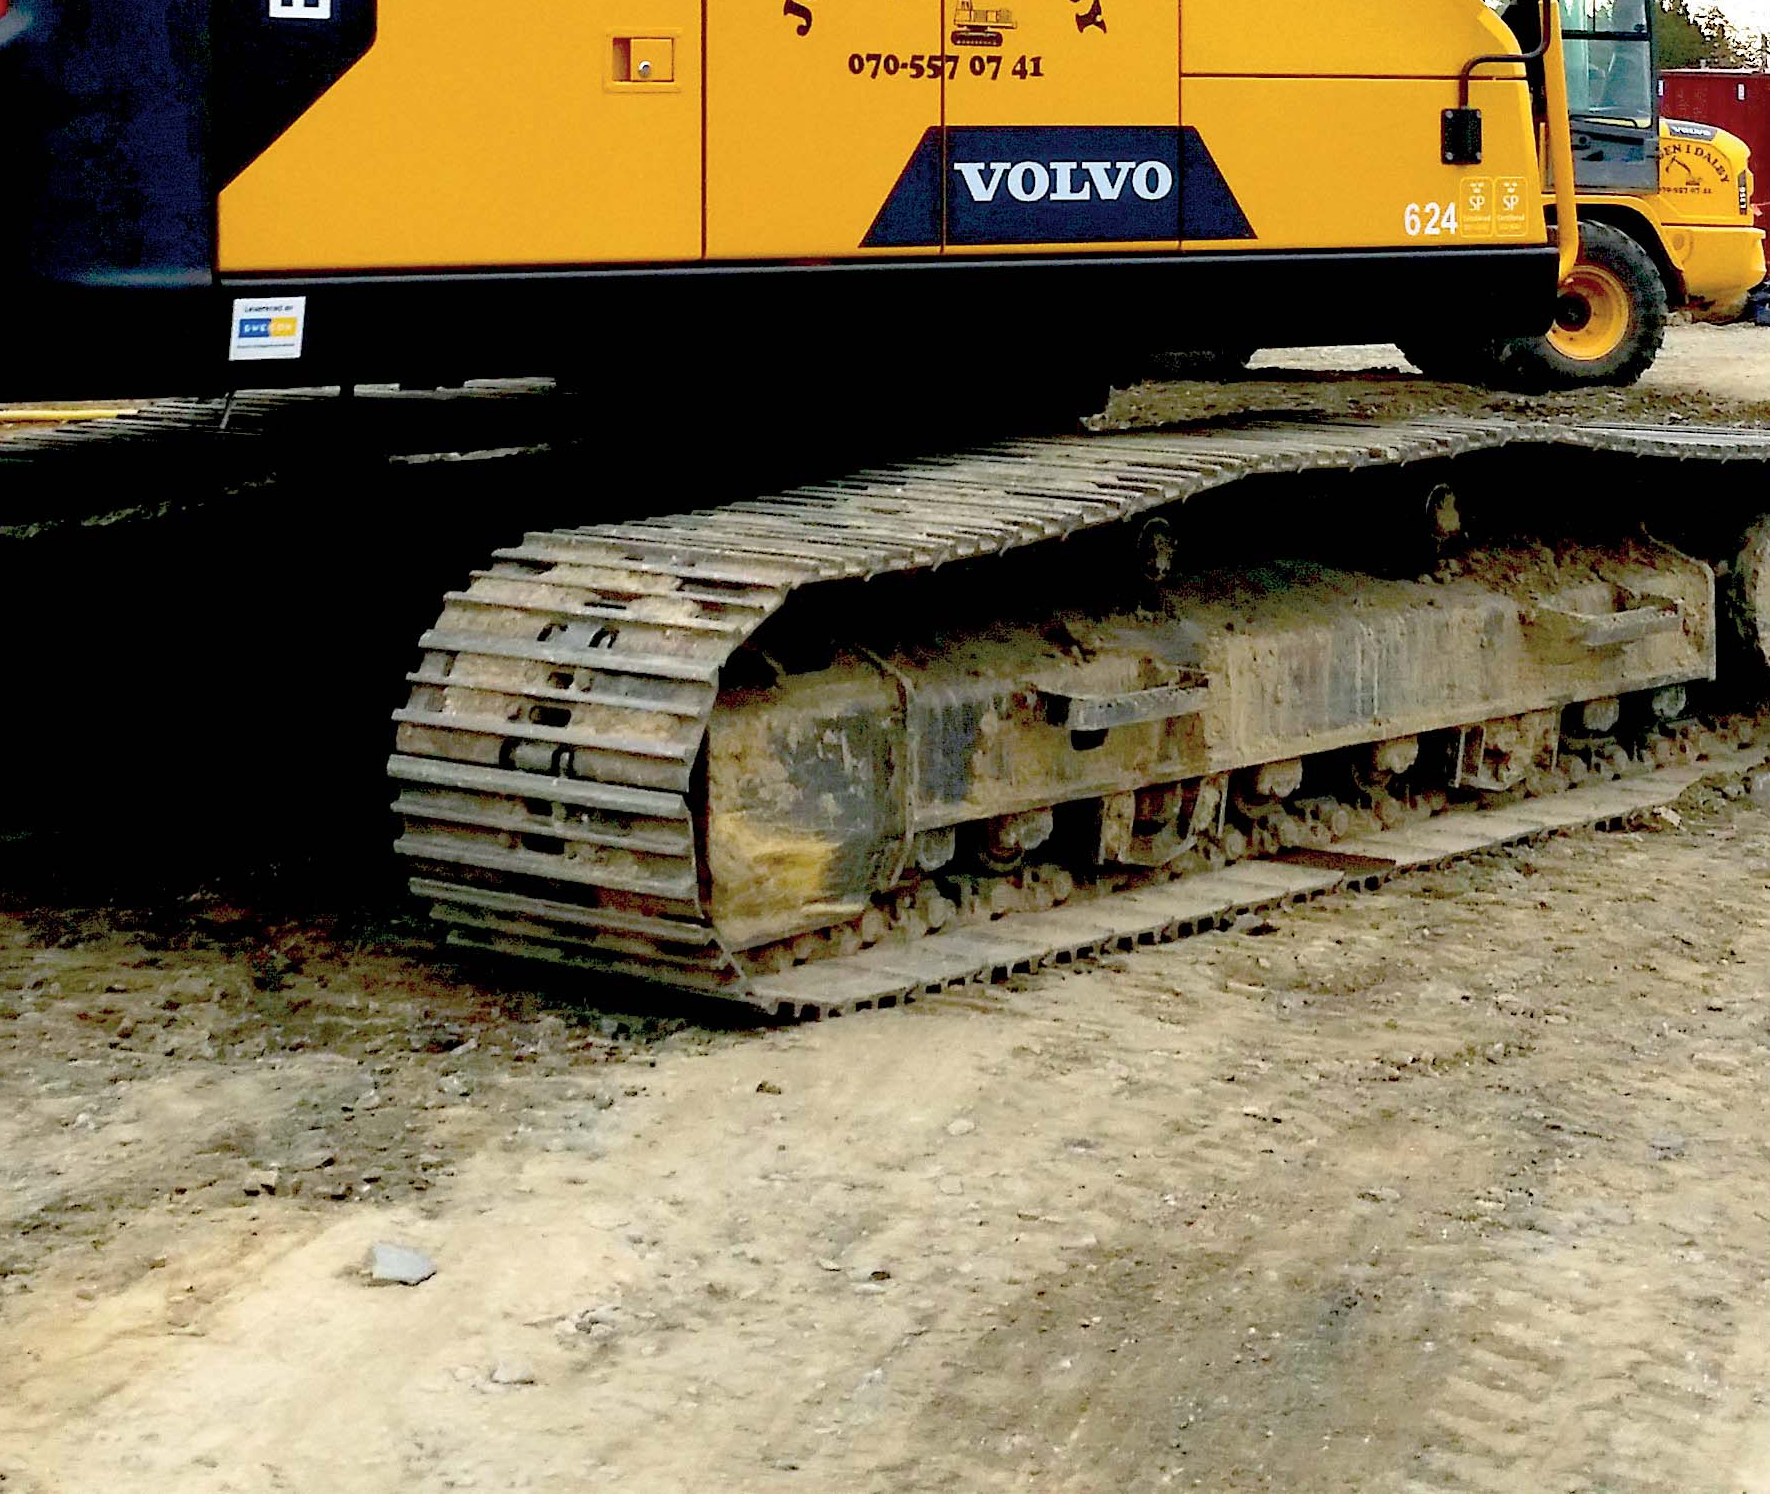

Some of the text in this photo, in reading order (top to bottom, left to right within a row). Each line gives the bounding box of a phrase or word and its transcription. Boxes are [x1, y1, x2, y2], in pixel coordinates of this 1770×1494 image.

[848, 53, 1045, 80] 070-557 07 41
[1670, 126, 1711, 136] VOLVO
[954, 160, 1173, 202] VOLVO
[1404, 202, 1459, 236] 624
